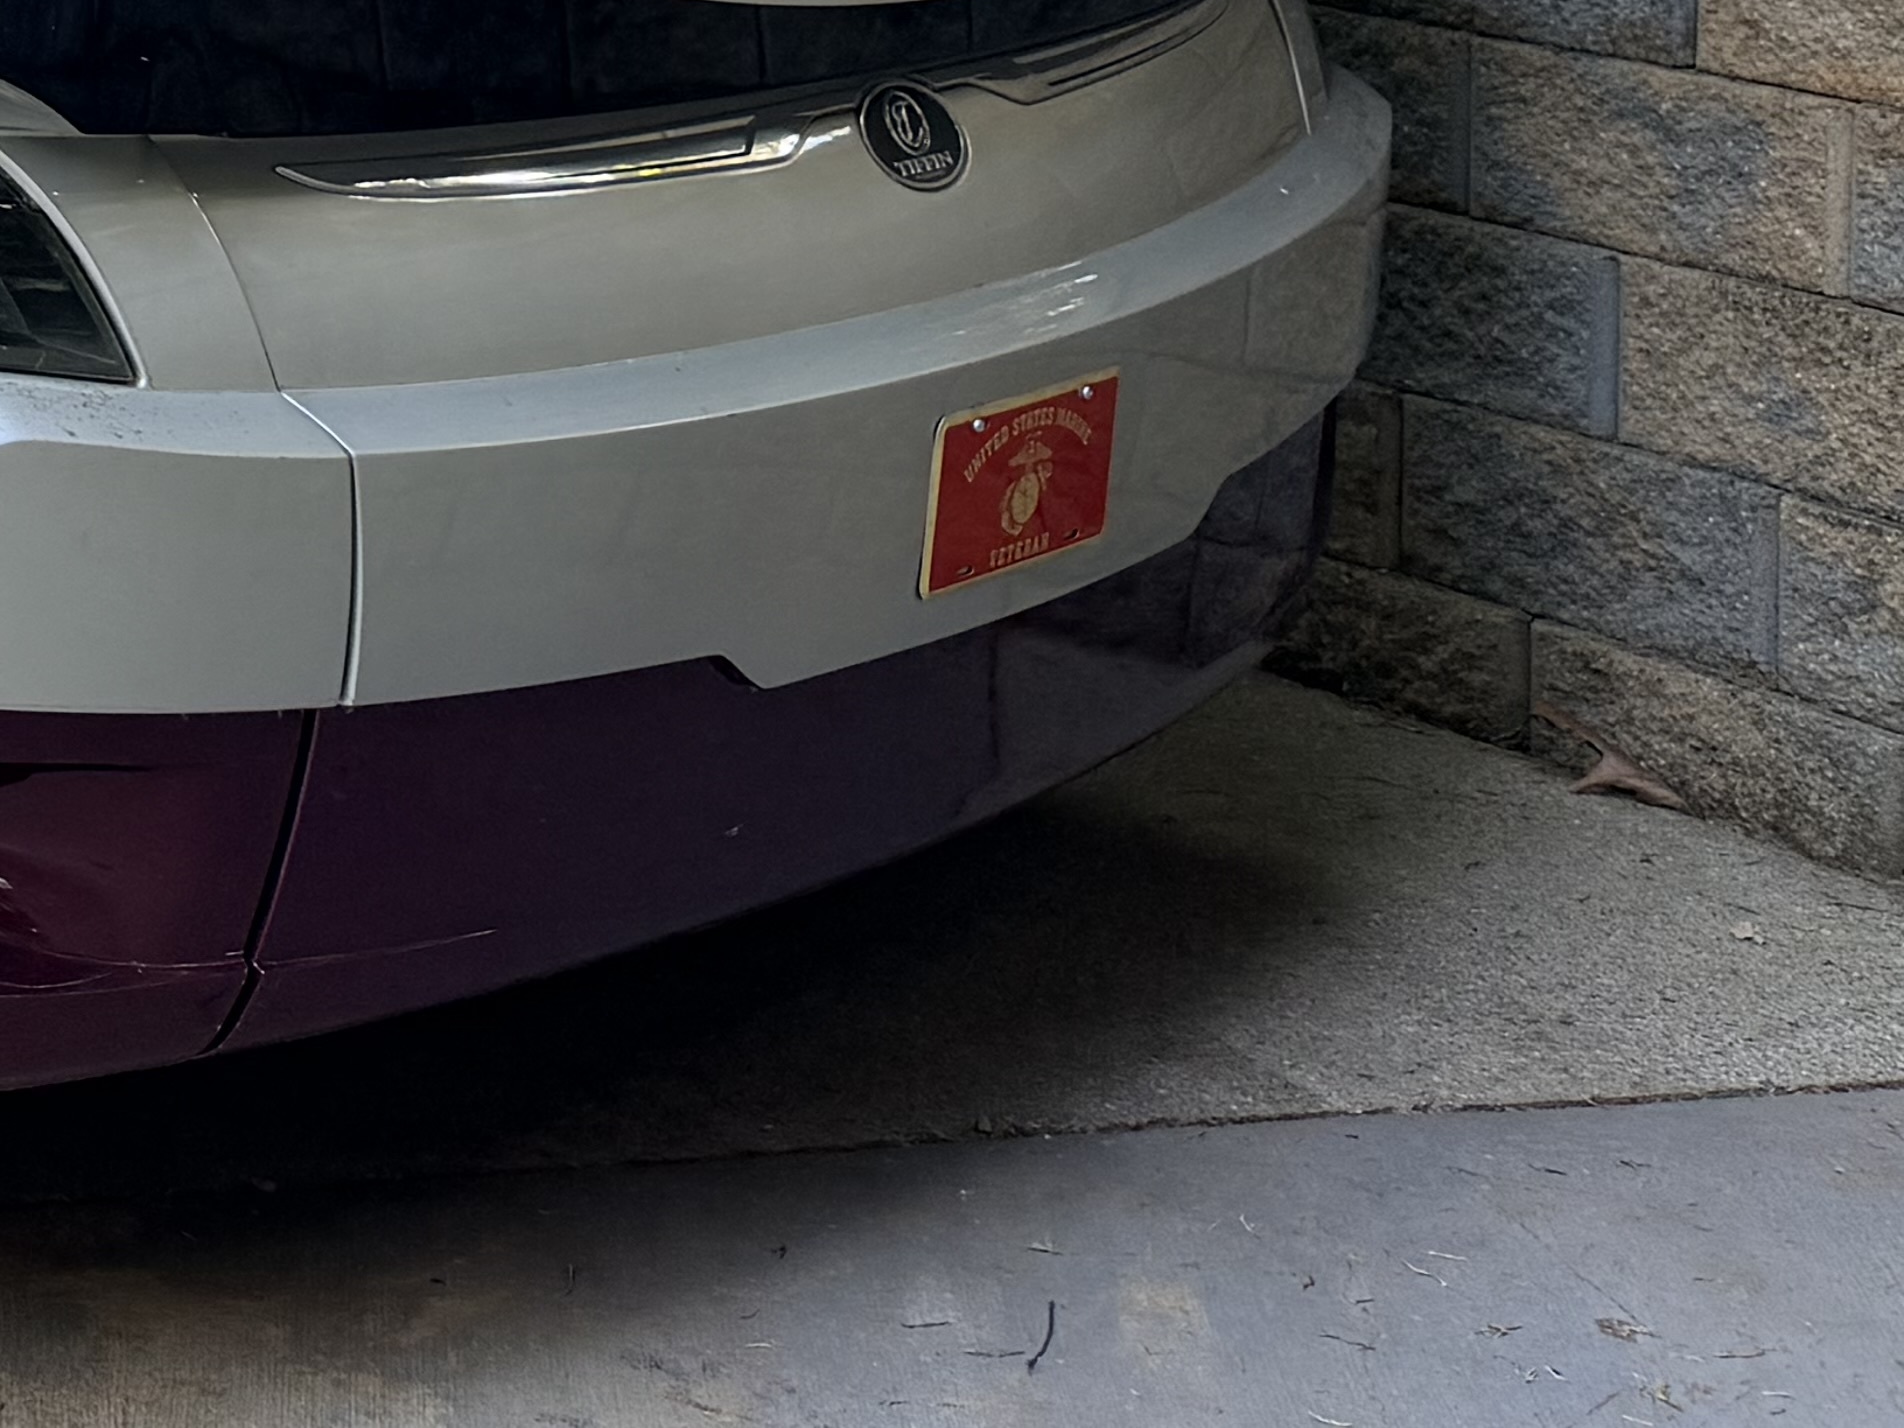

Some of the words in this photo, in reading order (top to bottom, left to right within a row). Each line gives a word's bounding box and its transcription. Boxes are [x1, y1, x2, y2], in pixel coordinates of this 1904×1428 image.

[894, 150, 955, 177] TIFFIN
[963, 425, 1010, 484] UNITED
[1012, 406, 1055, 436] STATES
[989, 532, 1050, 568] VETERAN
